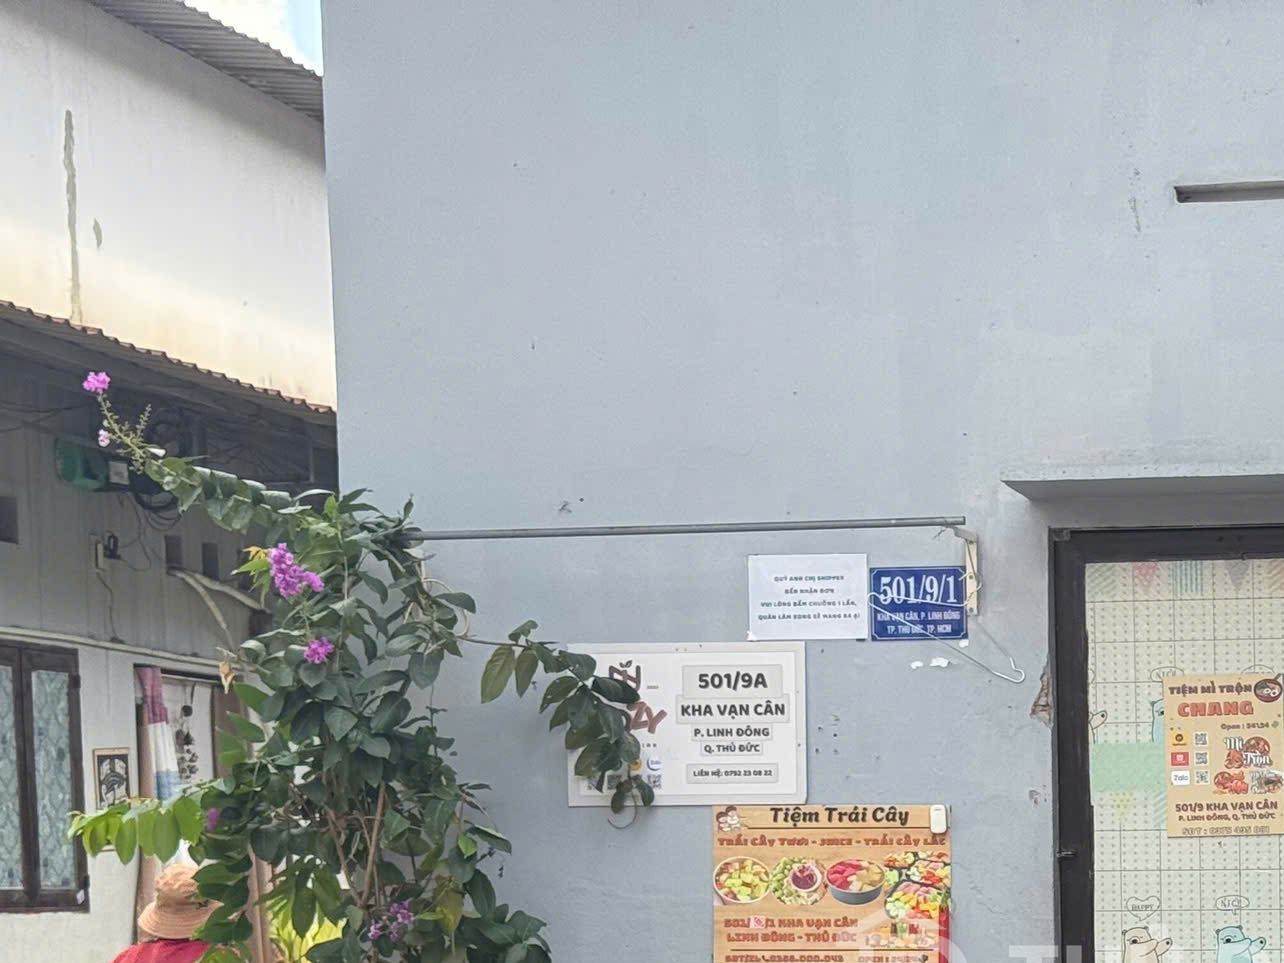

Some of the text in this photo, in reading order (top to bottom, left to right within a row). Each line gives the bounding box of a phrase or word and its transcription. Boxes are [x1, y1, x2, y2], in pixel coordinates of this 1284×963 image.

[880, 574, 958, 605] 501/9/1
[698, 672, 768, 692] 501/9A
[681, 700, 786, 720] KHA VẠN CÂN
[1177, 700, 1254, 717] CHANG
[694, 724, 770, 737] P. LINH ĐÔNG
[716, 741, 736, 753] THỦ
[738, 740, 761, 752] ĐỨC
[1206, 802, 1228, 811] KHA
[1231, 801, 1254, 813] VẠN
[1255, 798, 1278, 810] CÂN
[770, 805, 910, 827] Tiệm Trái Cây
